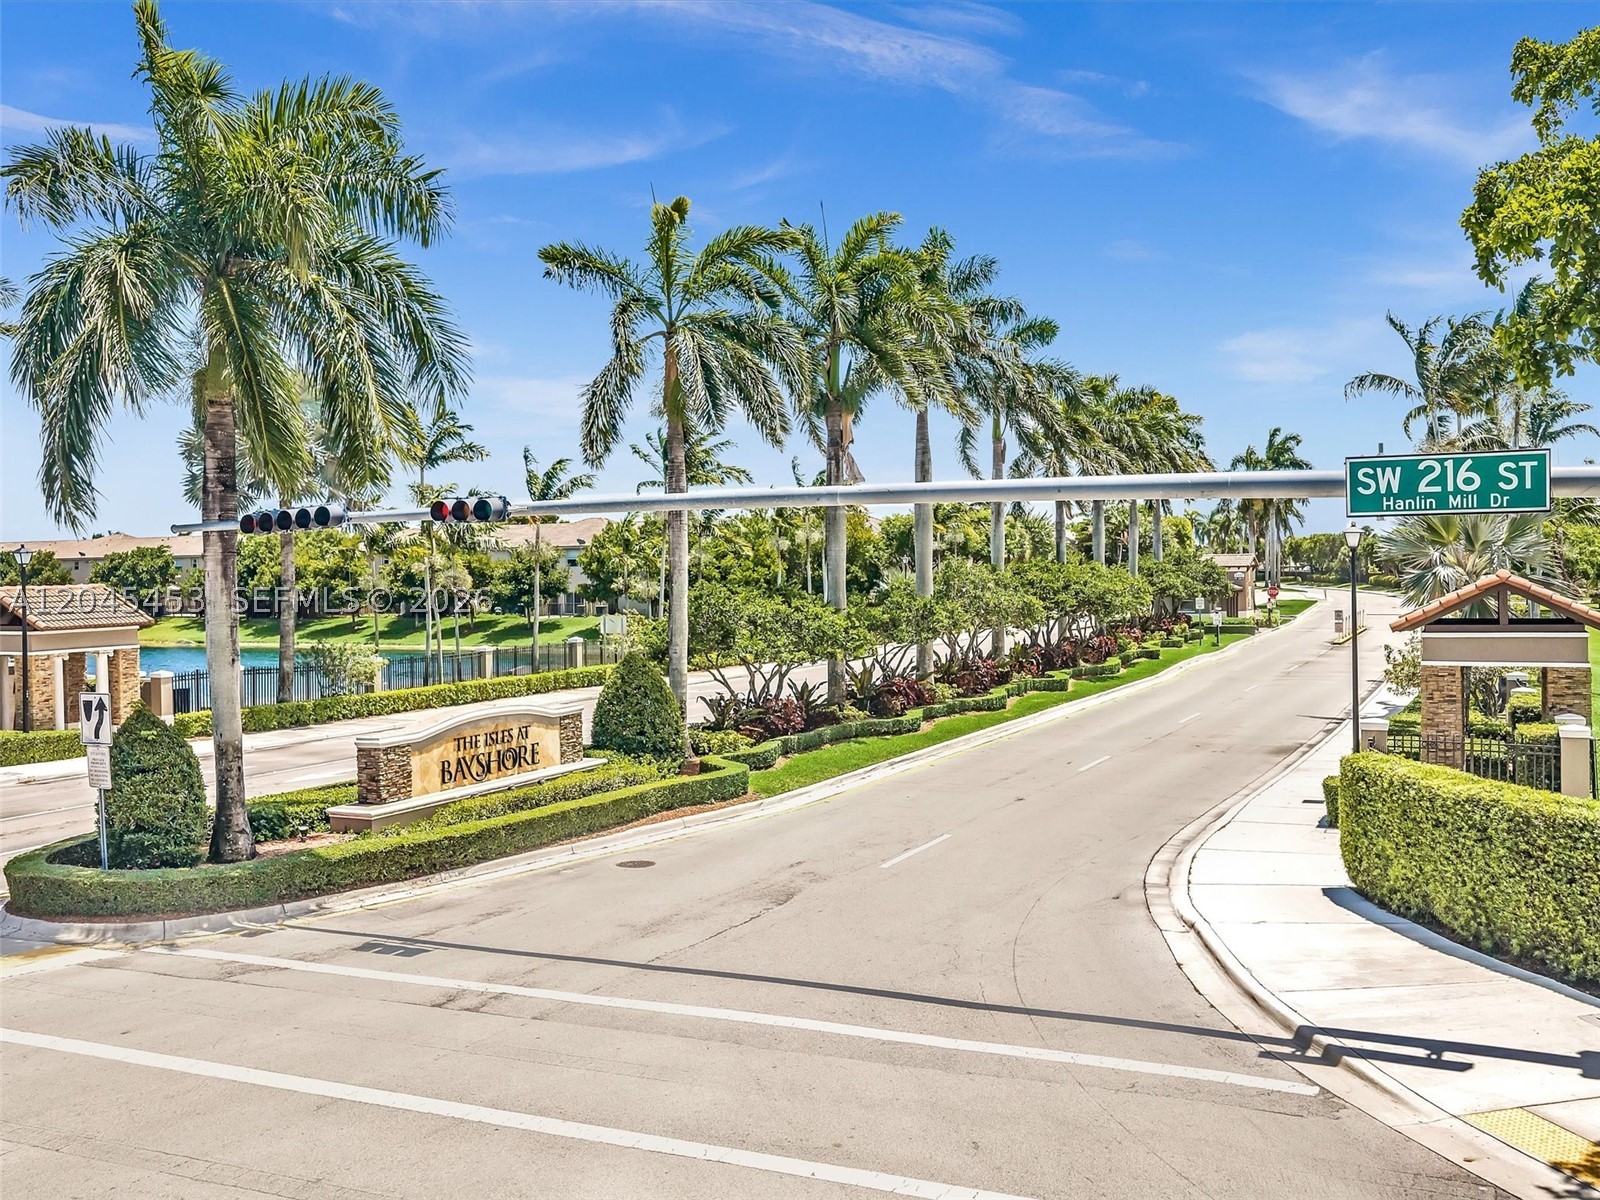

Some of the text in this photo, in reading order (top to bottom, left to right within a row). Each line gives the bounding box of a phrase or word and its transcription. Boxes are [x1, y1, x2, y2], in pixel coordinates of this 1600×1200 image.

[1357, 458, 1538, 495] SW 216 ST
[1383, 493, 1510, 511] Hanlin Mill Dr
[454, 725, 531, 752] THE ISLES AT
[441, 742, 540, 784] BAYSHORE
